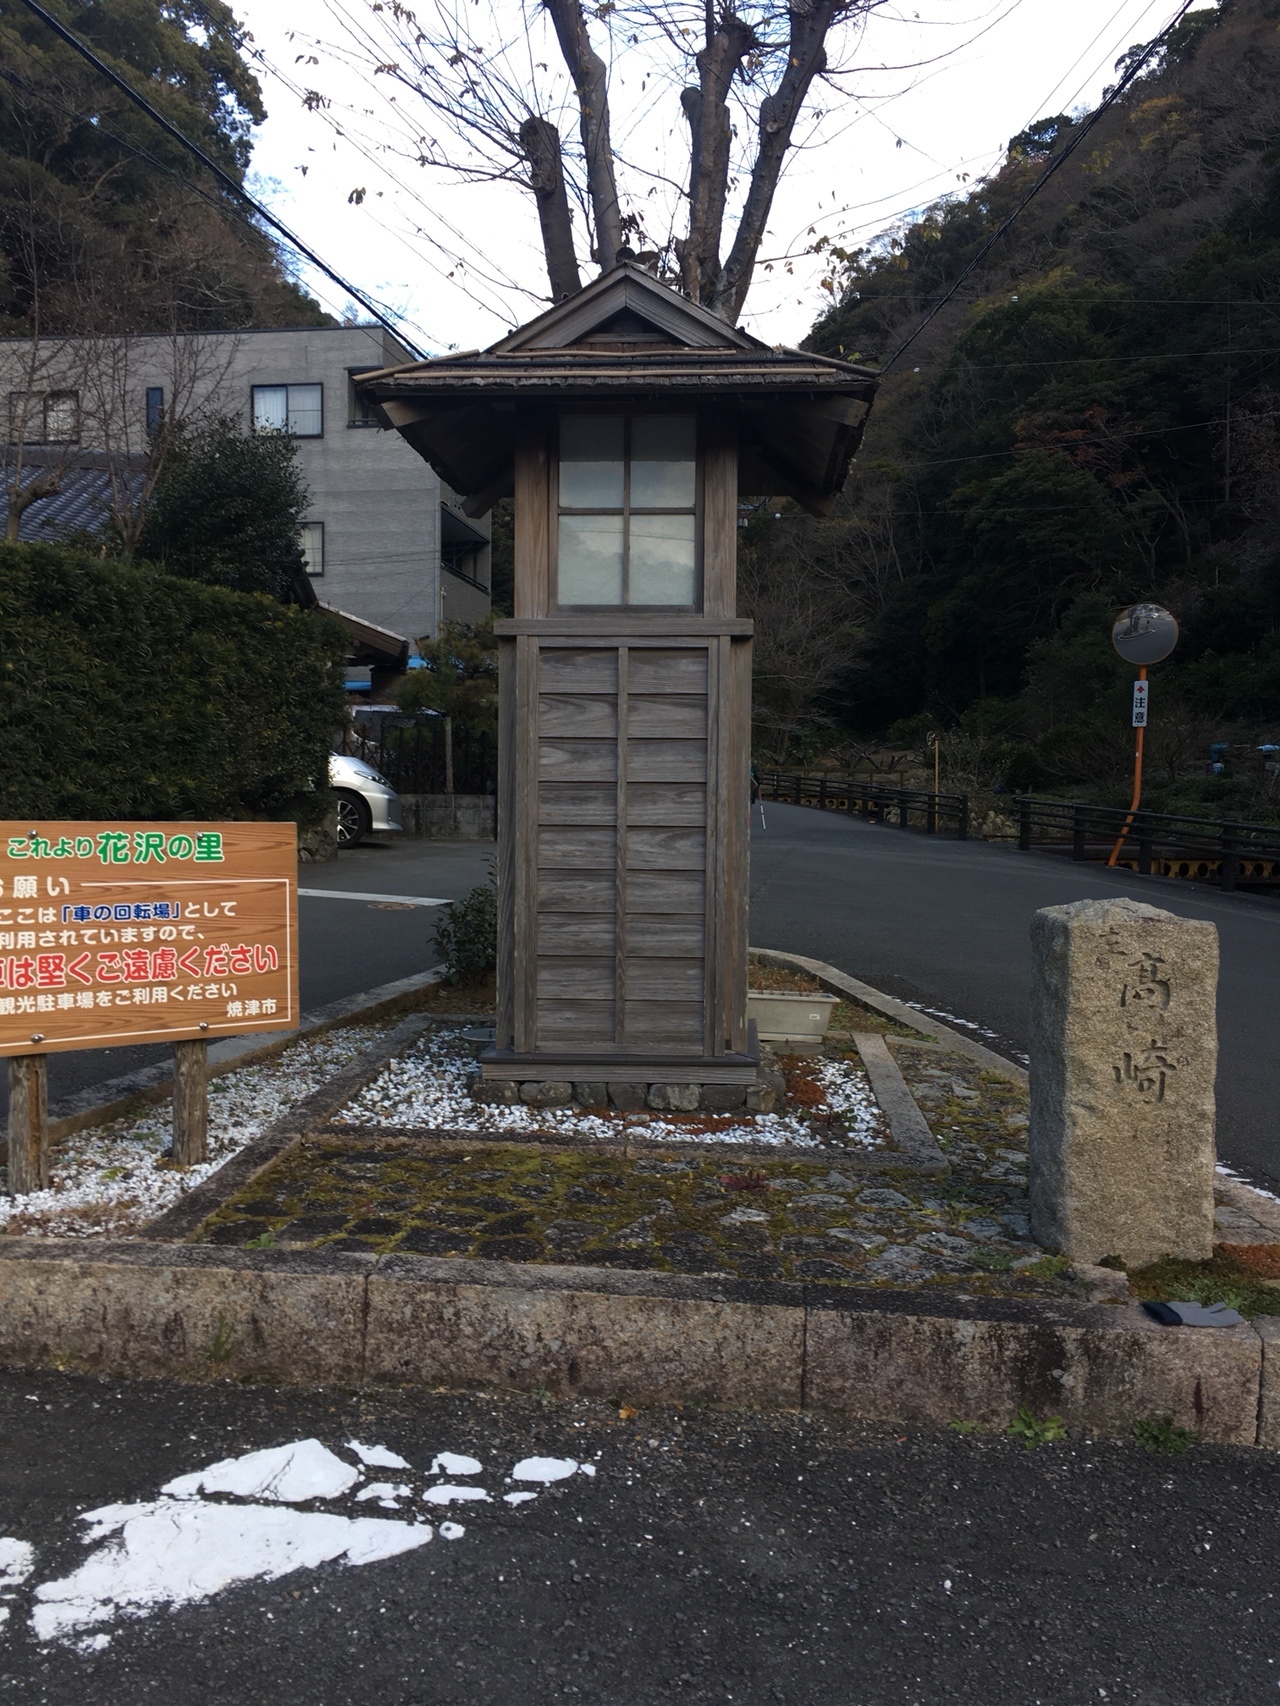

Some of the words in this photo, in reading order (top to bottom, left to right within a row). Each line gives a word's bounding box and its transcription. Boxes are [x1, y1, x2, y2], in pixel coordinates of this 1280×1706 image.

[1134, 697, 1146, 723] 注意
[8, 832, 224, 864] これより花沢の里
[0, 876, 70, 898] 願い
[0, 944, 278, 989] は堅くご遠慮ください
[0, 983, 238, 1015] 観光駐車場をご利用ください
[226, 998, 277, 1017] 焼津市
